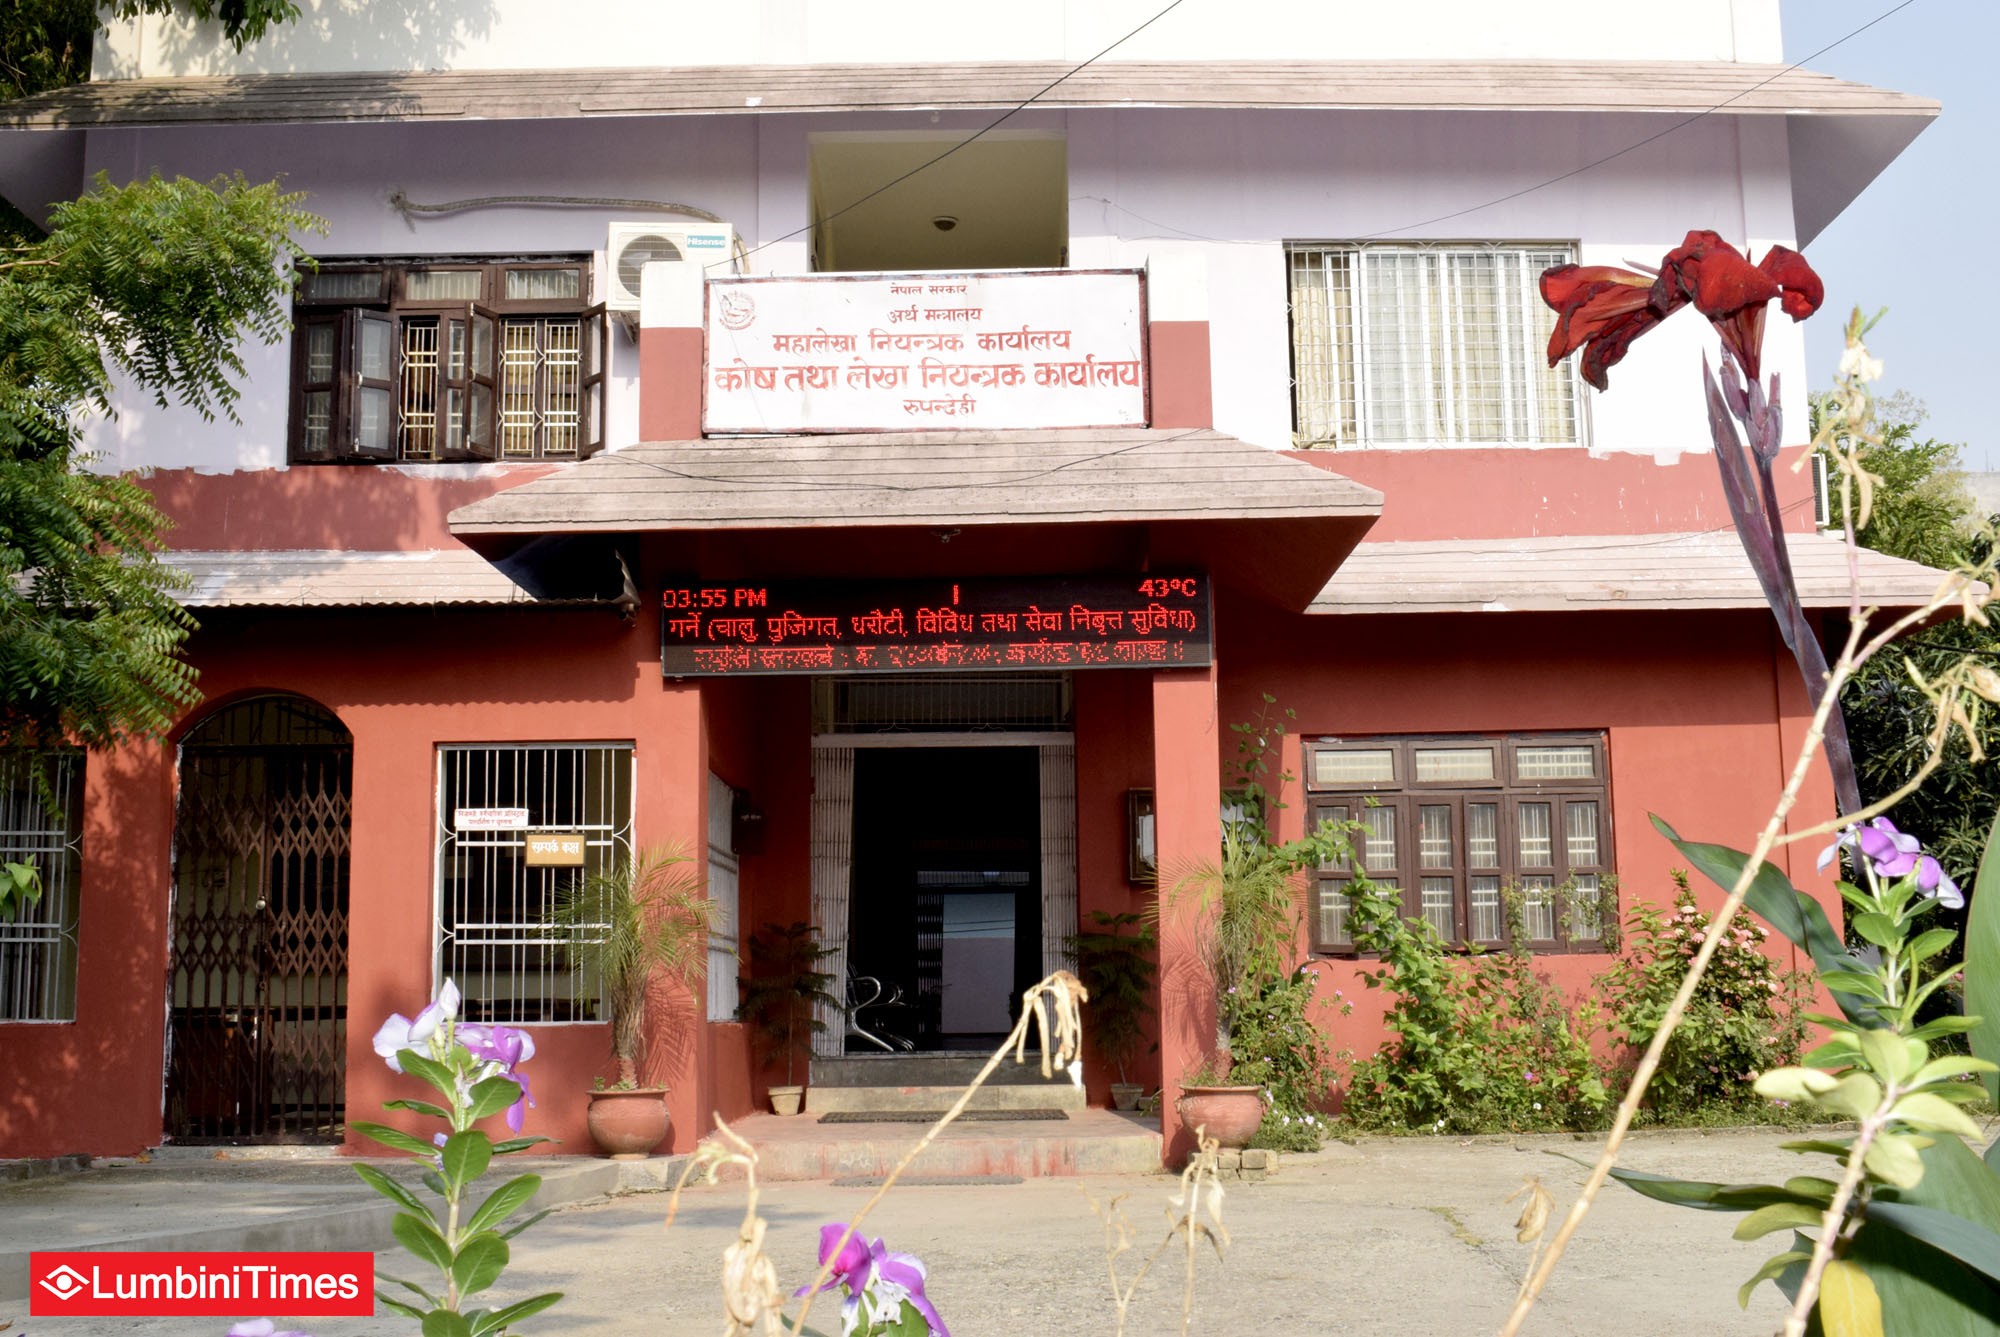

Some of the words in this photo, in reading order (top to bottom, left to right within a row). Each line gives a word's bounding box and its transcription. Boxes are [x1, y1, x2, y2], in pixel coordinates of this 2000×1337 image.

[687, 237, 725, 246] Hisense
[890, 282, 923, 294] नेपाल
[928, 285, 967, 295] सरकार
[887, 304, 918, 324] अर्थ
[924, 308, 983, 321] मन्त्रालय
[772, 327, 857, 354] महालेखा
[868, 327, 963, 352] नियन्त्रक
[975, 324, 1072, 351] कार्यालय
[714, 357, 779, 392] कोष
[782, 365, 840, 392] तथा
[846, 355, 910, 391] लेखा
[918, 356, 1026, 389] नियन्त्रक
[1033, 353, 1140, 388] कार्यालय
[663, 589, 727, 608] 03:55
[734, 588, 767, 608] PM
[915, 607, 974, 634] विविध
[980, 613, 1018, 633] तथा
[1021, 605, 1063, 632] सेवा
